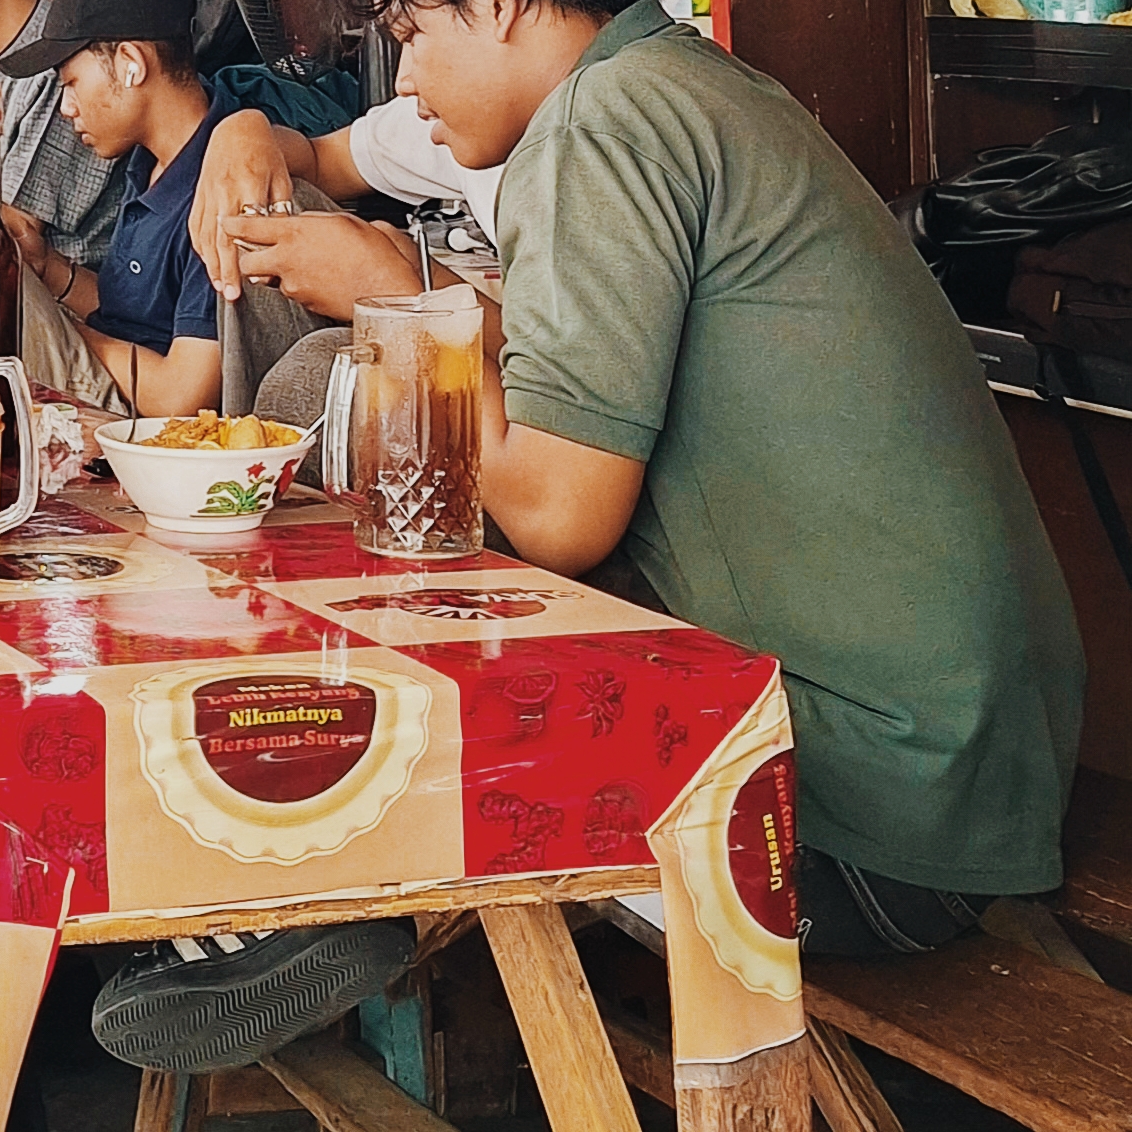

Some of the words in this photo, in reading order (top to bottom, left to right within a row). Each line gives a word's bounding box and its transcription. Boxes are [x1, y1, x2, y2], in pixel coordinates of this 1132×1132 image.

[229, 706, 343, 727] Nikmatnya
[208, 734, 300, 754] Bersama
[762, 813, 783, 892] Urusan
